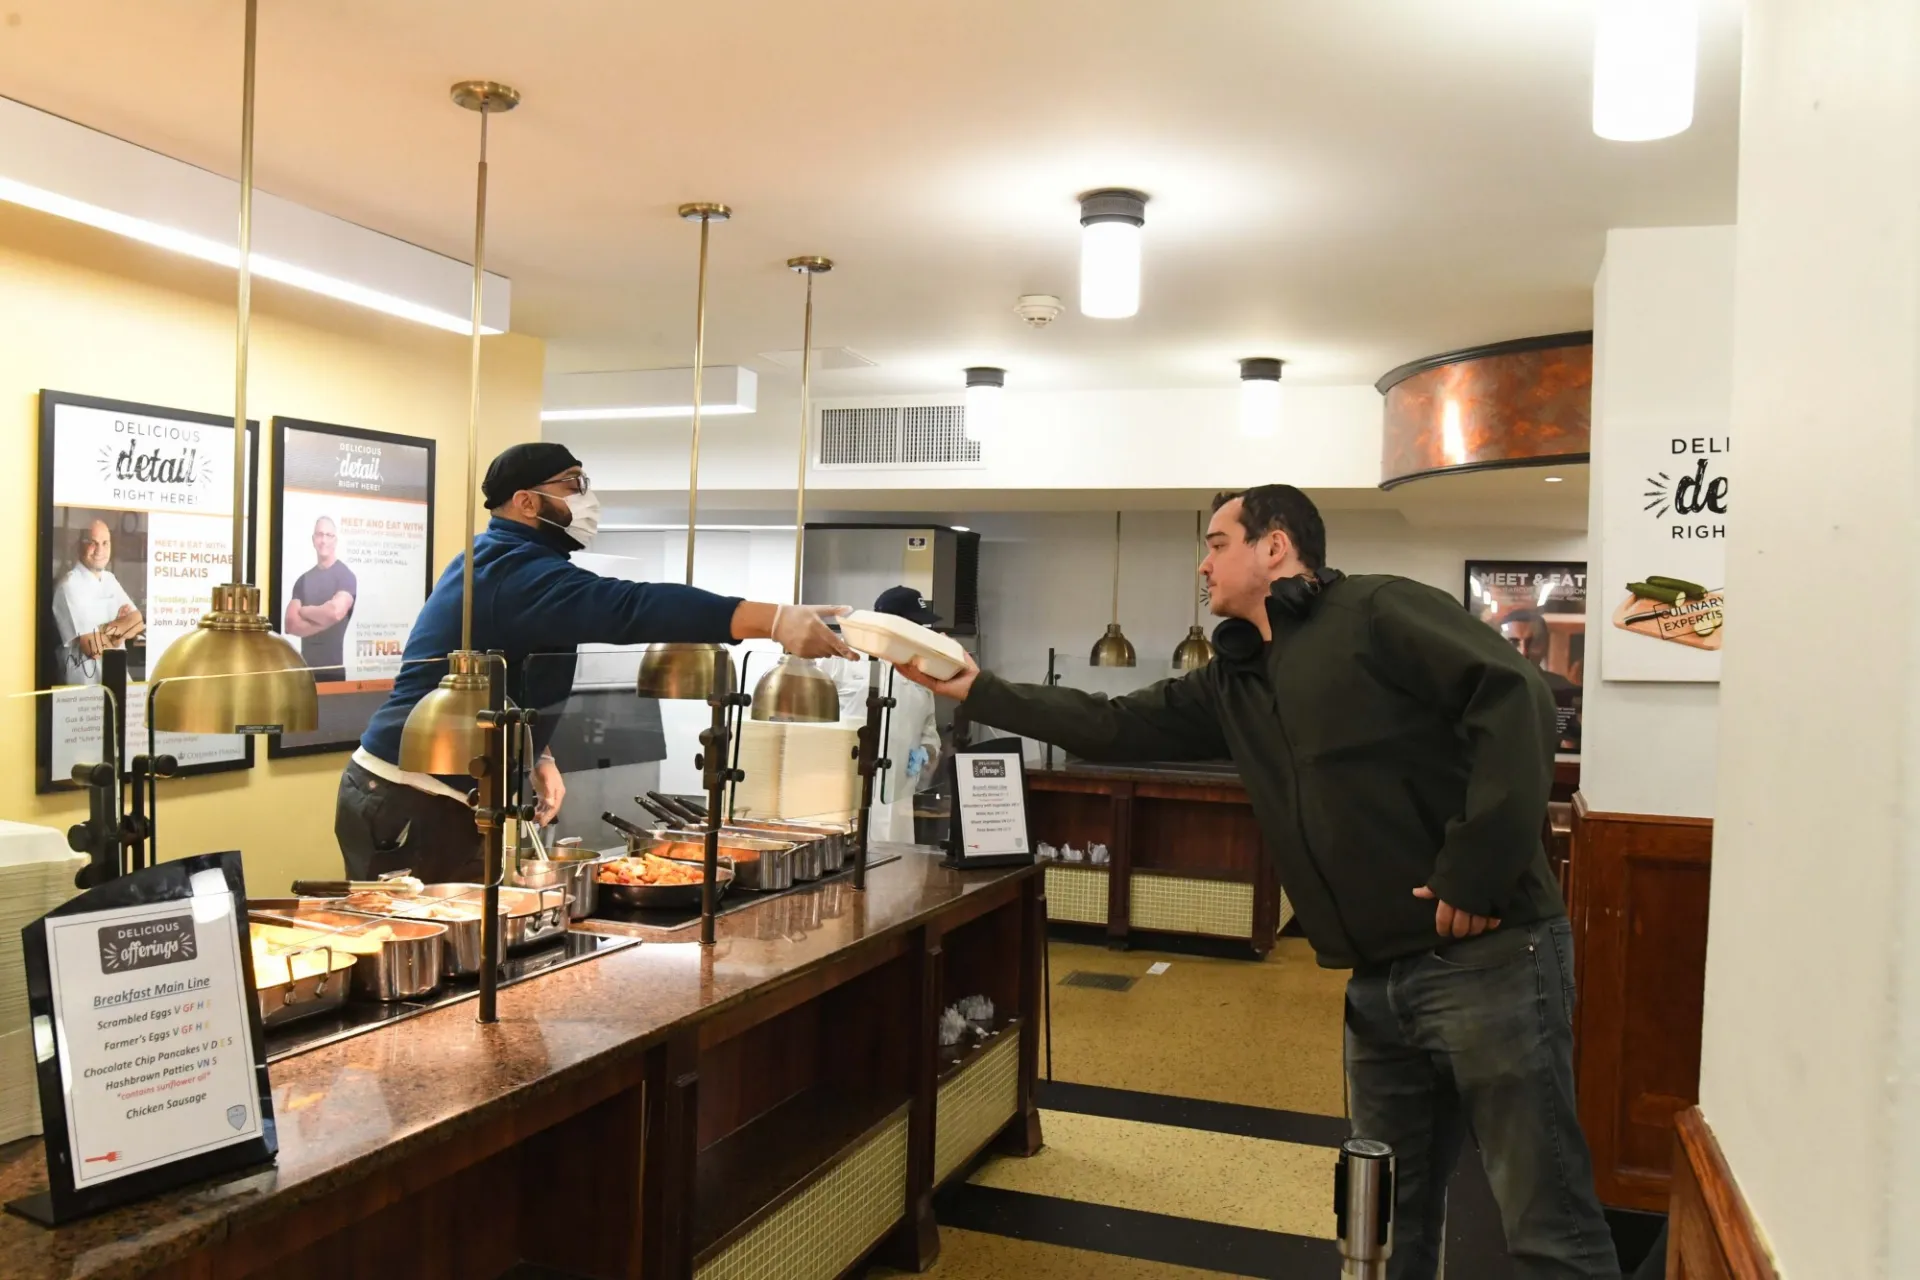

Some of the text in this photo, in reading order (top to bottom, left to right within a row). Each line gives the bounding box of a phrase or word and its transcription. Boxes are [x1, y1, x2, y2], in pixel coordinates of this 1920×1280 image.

[114, 420, 200, 442] DELICIOUS
[339, 442, 382, 456] DELICIOUS
[1672, 437, 1729, 455] DELI
[116, 438, 198, 485] detail
[340, 452, 380, 481] detail
[338, 480, 380, 491] RIGHT HERE!
[1675, 458, 1728, 515] de
[113, 488, 198, 505] RIGHT HERE!
[341, 517, 424, 531] MEET AND EAT WITH
[1672, 525, 1725, 539] RIGH
[154, 551, 187, 563] CHEF
[154, 566, 208, 578] PSILAKIS
[1481, 573, 1586, 587] MEET & EAT
[161, 607, 173, 615] PM
[153, 618, 173, 626] John
[174, 618, 187, 628] Jay
[1664, 610, 1723, 631] EXPERTIS
[118, 922, 180, 939] DELICIOUS
[121, 939, 179, 967] offerings
[93, 976, 210, 1007] Breakfast Main Line
[97, 1011, 148, 1030] Scrambled
[150, 1007, 172, 1022] Eggs
[174, 1005, 181, 1014] V
[183, 1003, 195, 1013] GF
[197, 1000, 204, 1009] H
[148, 1029, 170, 1043] Eggs
[172, 1027, 179, 1036] V
[181, 1024, 193, 1035] GF
[195, 1022, 203, 1031] H
[83, 1061, 132, 1078] Chocolate
[135, 1055, 156, 1068] Chip
[158, 1043, 200, 1061] Pancakes
[202, 1042, 209, 1051] V
[211, 1040, 218, 1049] D
[227, 1037, 233, 1046] S
[105, 1056, 218, 1091] Hashbrown Patties VN S
[156, 1076, 196, 1092] sunflower
[126, 1091, 207, 1120] Chicken Sausage
